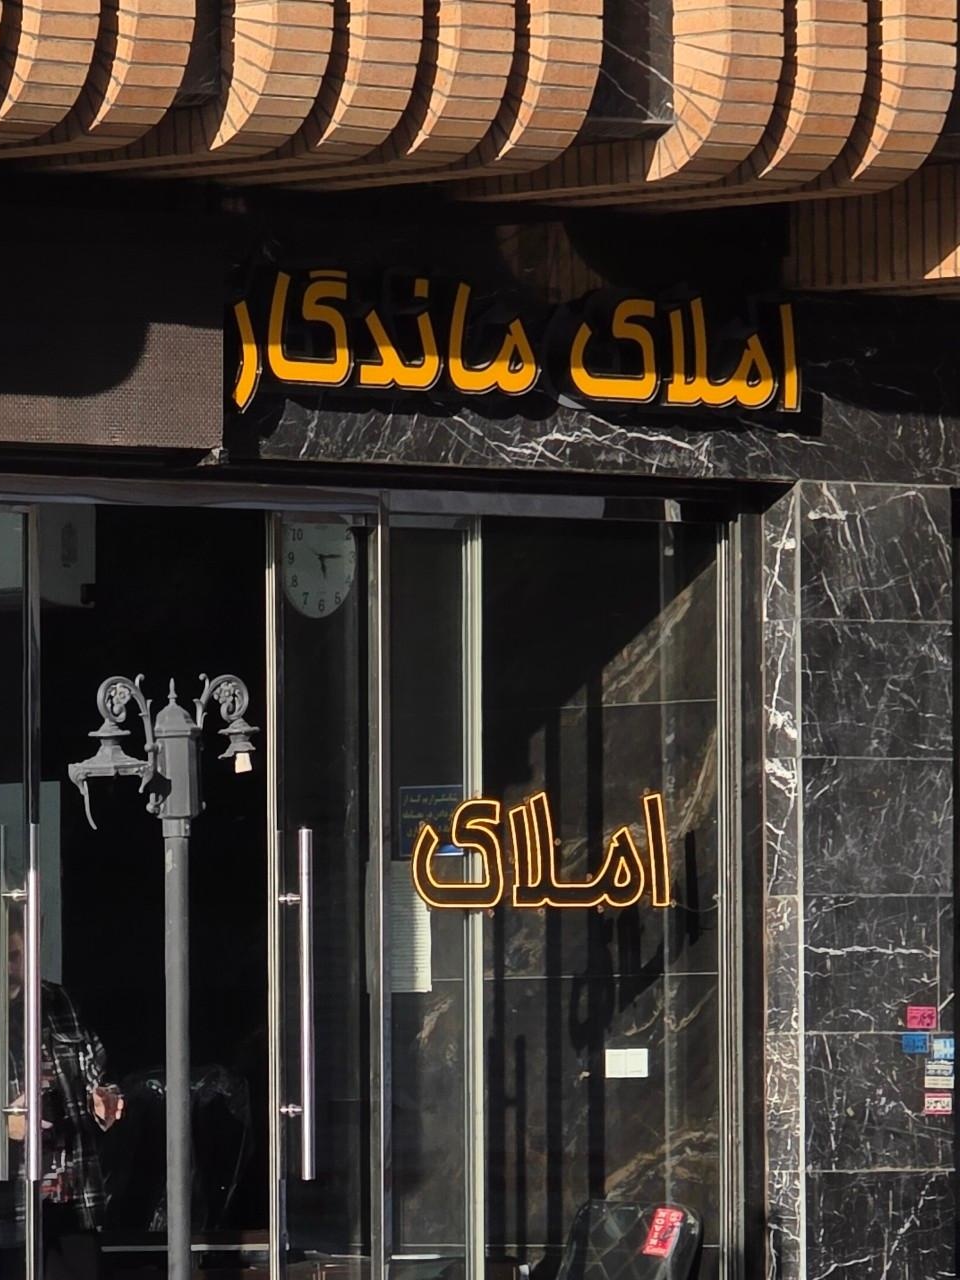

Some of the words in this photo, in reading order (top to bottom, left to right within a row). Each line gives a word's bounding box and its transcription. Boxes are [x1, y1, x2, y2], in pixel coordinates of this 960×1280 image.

[232, 270, 538, 412] ماندگار
[570, 297, 800, 412] املاک
[289, 528, 304, 541] 10
[287, 551, 295, 565] 9
[290, 575, 299, 588] 8
[302, 592, 309, 606] 7
[318, 599, 326, 612] 6
[411, 791, 671, 909] املاک
